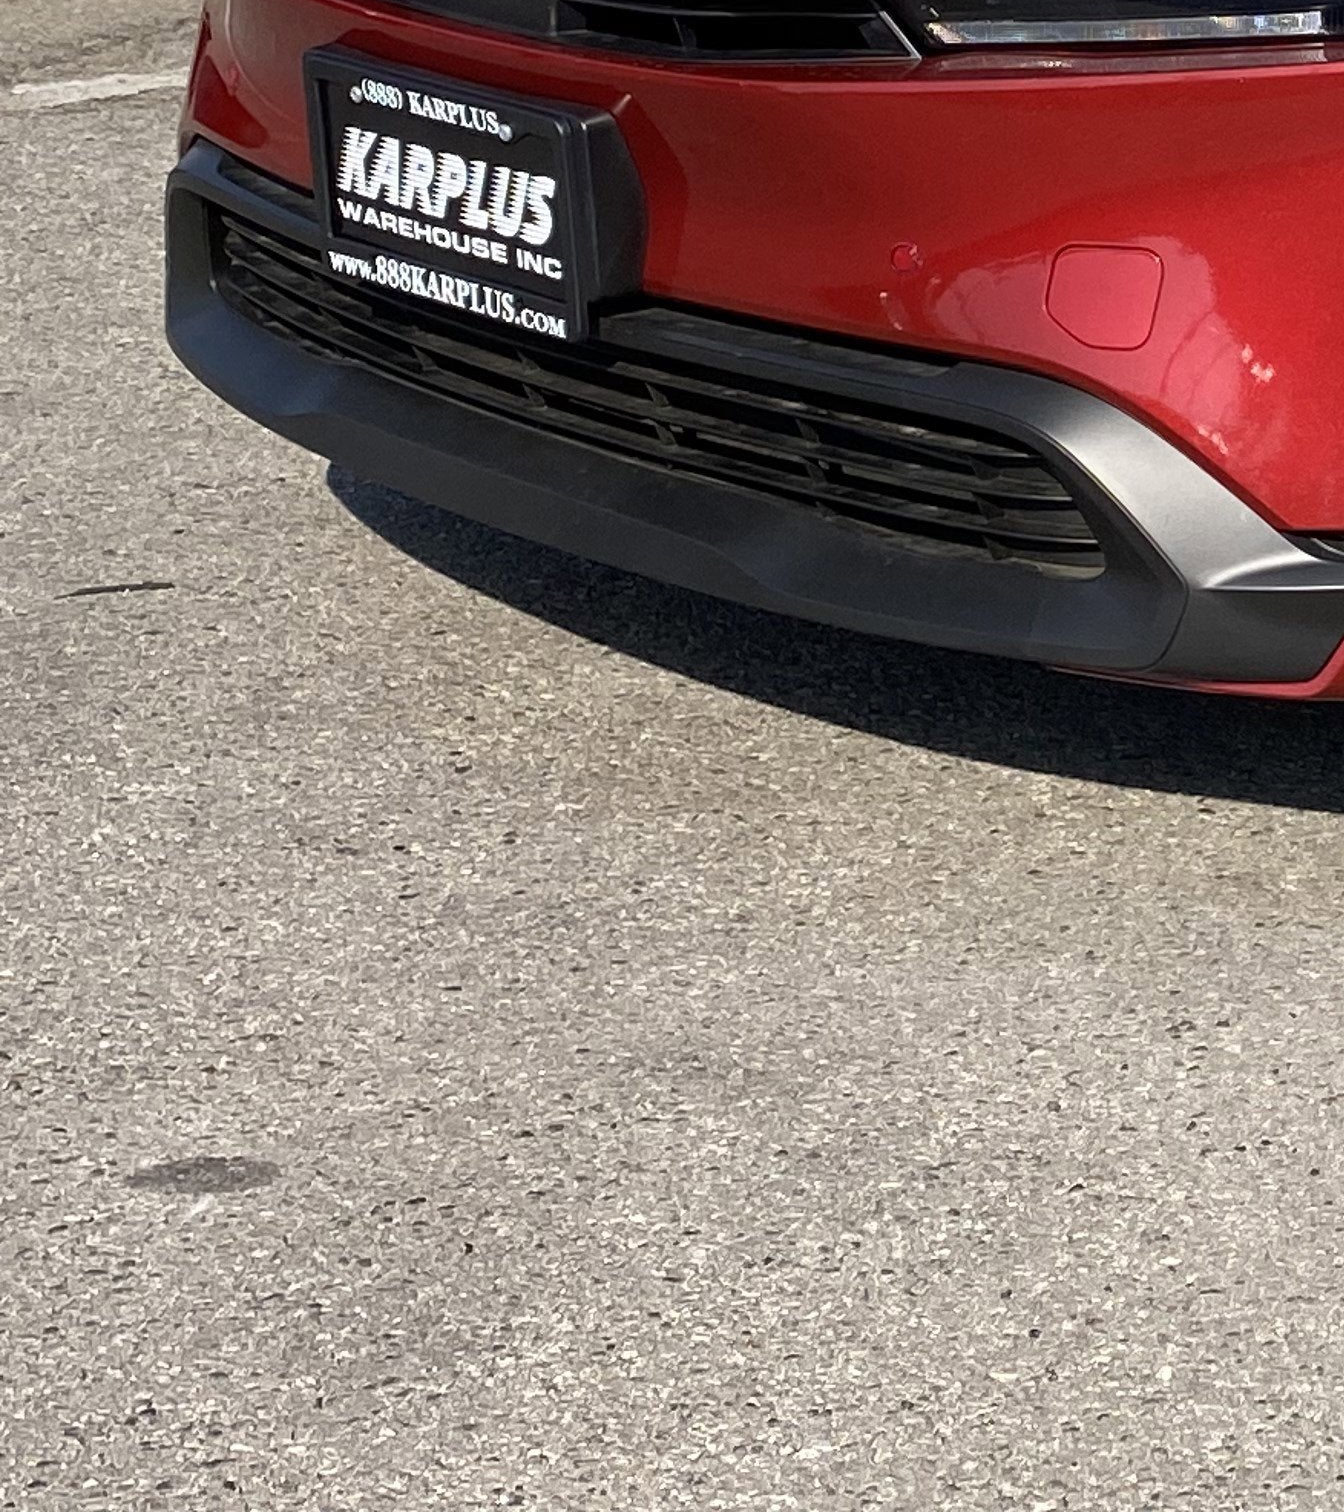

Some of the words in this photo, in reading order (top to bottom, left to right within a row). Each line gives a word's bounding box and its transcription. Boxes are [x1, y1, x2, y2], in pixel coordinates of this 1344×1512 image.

[361, 77, 403, 110] (888)
[406, 90, 500, 135] KARPLUS
[336, 125, 556, 246] KARPLUS
[336, 196, 509, 265] WAREHOUSE
[515, 248, 563, 280] INC
